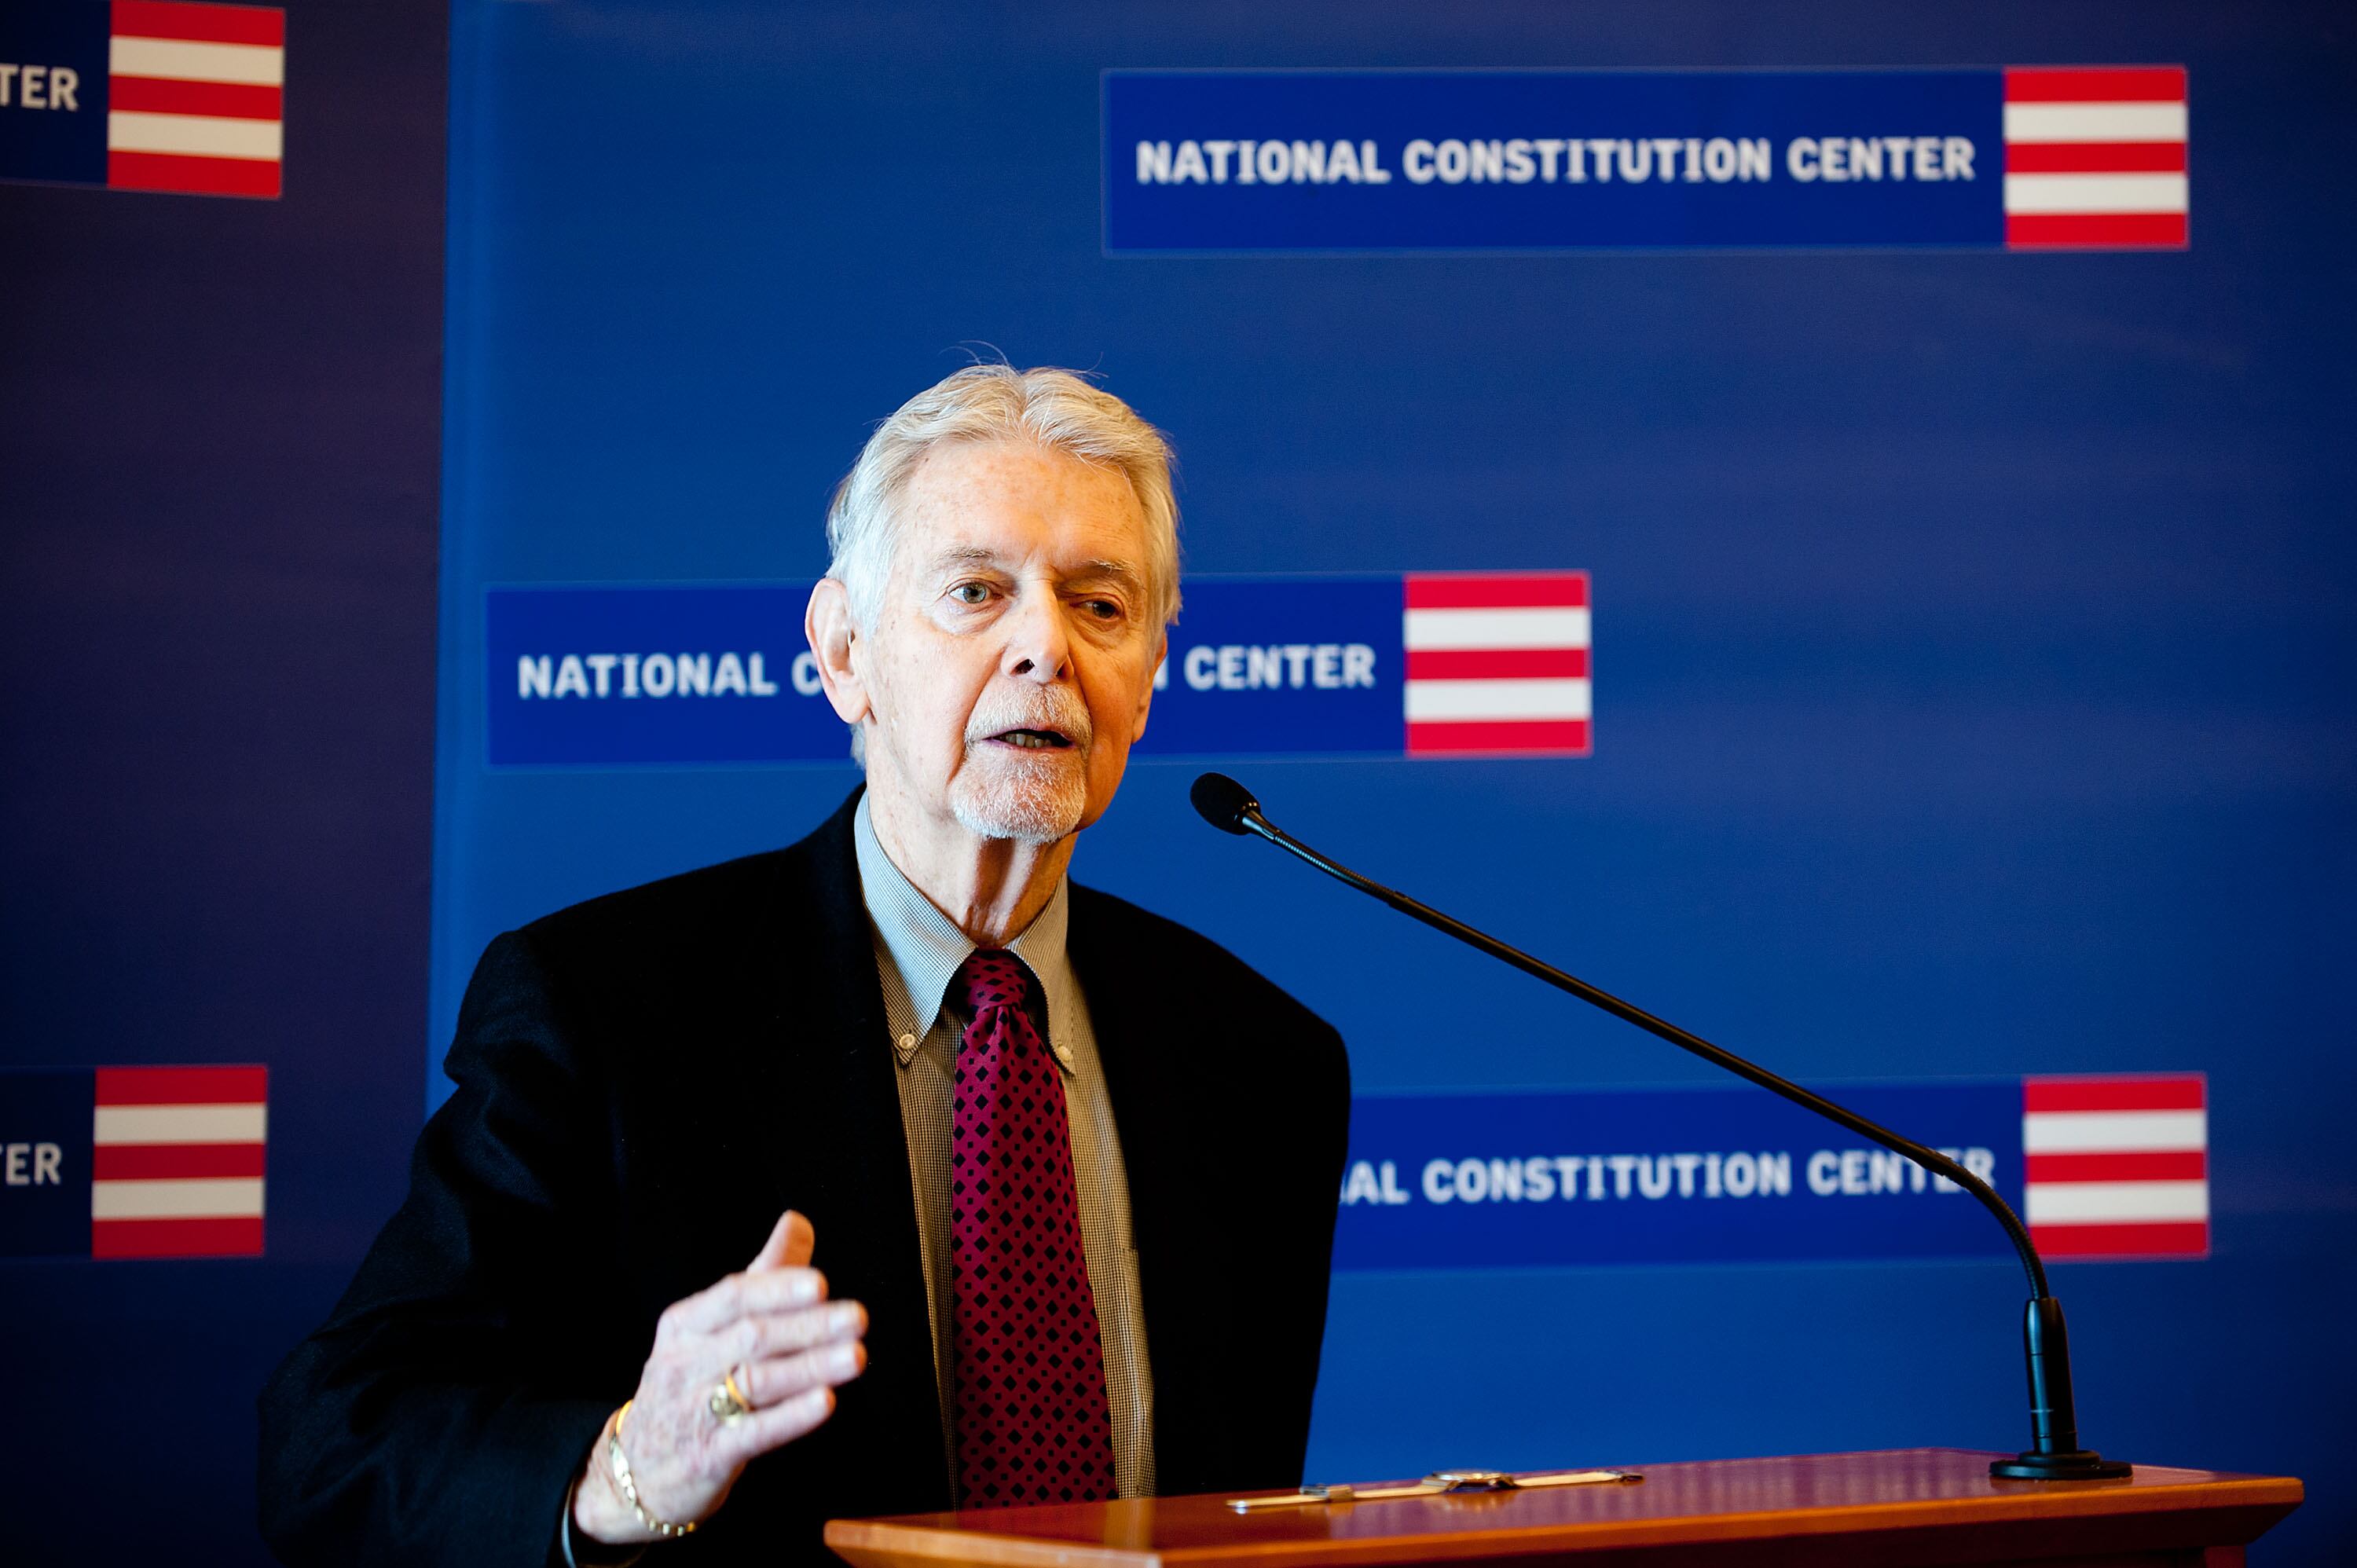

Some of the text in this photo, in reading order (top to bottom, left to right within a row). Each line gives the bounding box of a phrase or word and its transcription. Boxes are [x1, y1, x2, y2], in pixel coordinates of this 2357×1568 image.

[0, 63, 79, 111] TER
[1136, 137, 1975, 184] NATIONAL CONSTITUTION CENTER
[518, 652, 778, 698] NATIONAL
[1184, 644, 1376, 690] CENTER
[0, 1142, 62, 1185] ER
[1339, 1159, 1410, 1205] AL
[1422, 1153, 1791, 1203] CONSTITUTION
